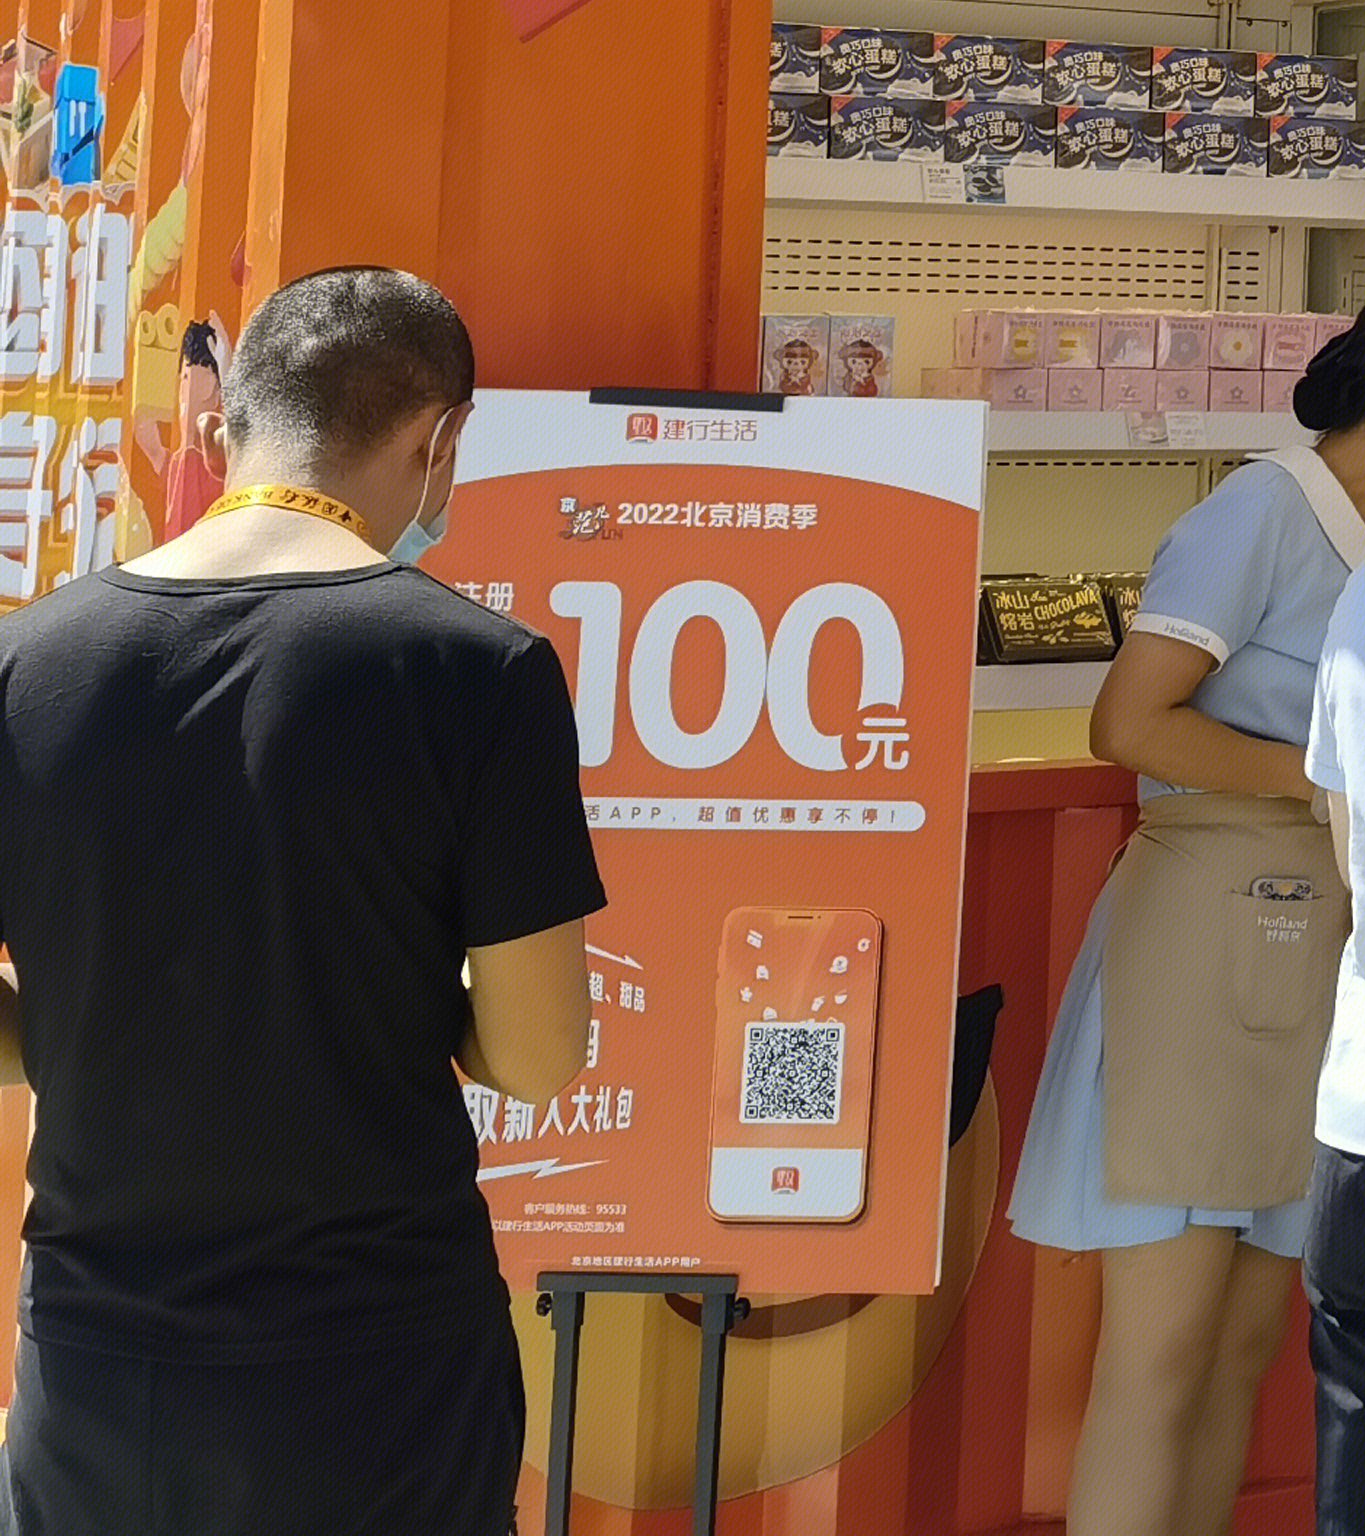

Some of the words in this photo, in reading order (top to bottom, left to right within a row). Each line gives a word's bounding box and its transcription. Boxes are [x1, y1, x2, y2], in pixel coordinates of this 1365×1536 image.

[663, 419, 757, 442] 建行生活
[617, 501, 818, 530] 2022北京消费季
[1034, 588, 1098, 621] CHOCOLAVA
